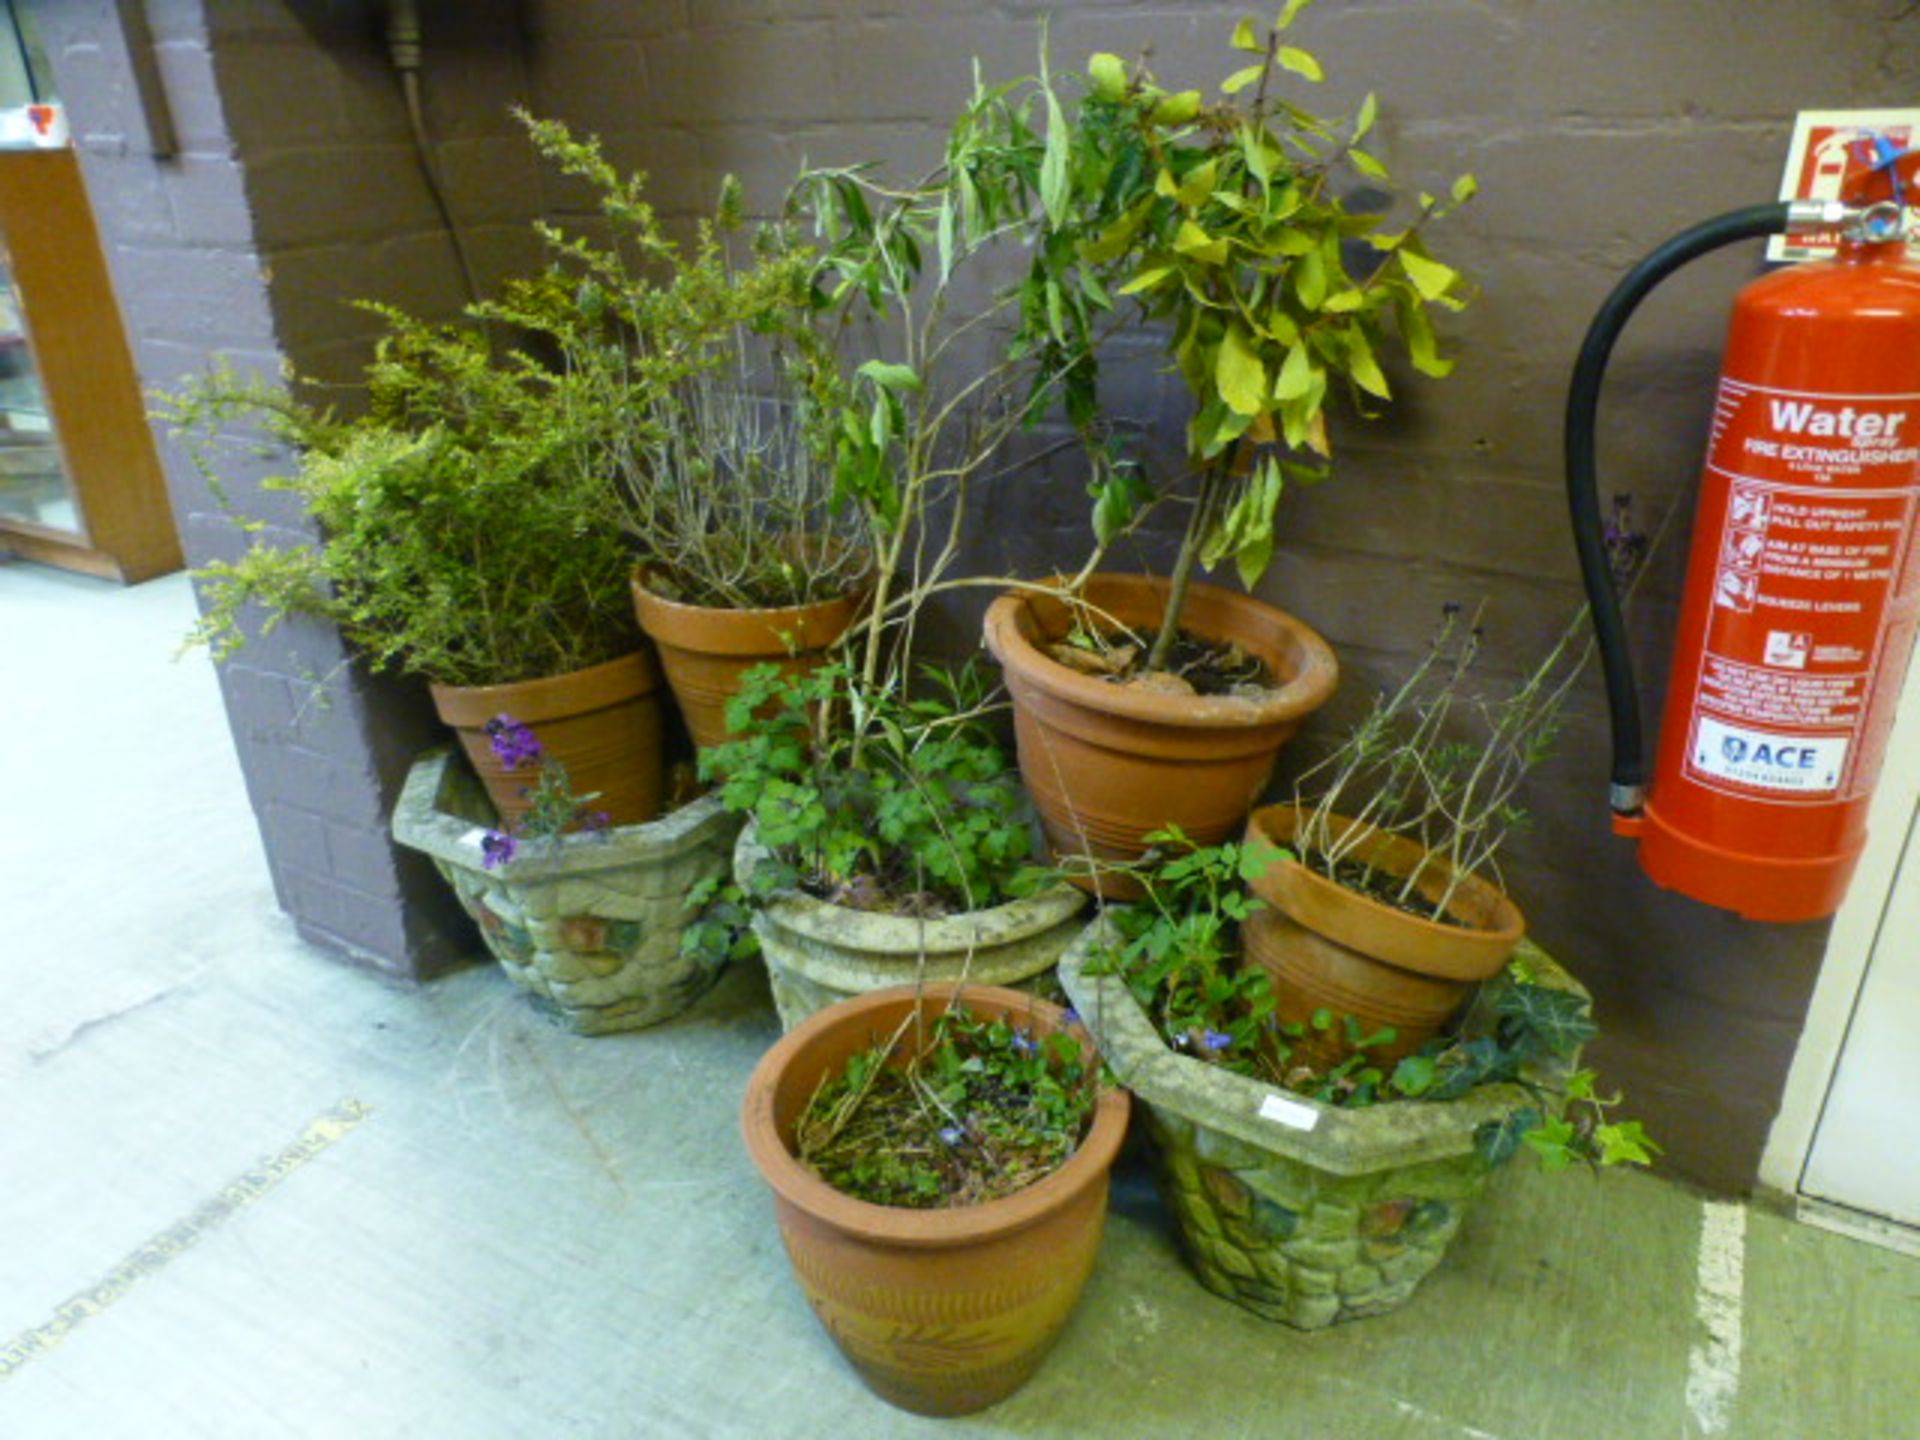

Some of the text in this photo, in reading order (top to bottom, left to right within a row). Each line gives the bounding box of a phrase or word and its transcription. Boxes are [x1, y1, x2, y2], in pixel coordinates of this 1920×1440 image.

[1769, 399, 1907, 436] Water
[1743, 436, 1918, 464] FIRE EXTINGUISHER
[1771, 504, 1808, 517] HOLD
[1771, 515, 1800, 529] PULL
[1803, 519, 1831, 530] OUT
[1833, 521, 1880, 532] SAFETY
[1790, 542, 1807, 553] AT
[1763, 563, 1822, 580] DISTANCE
[1824, 569, 1842, 581] OF
[1814, 601, 1861, 613] LEVERS
[1752, 743, 1818, 769] ACE
